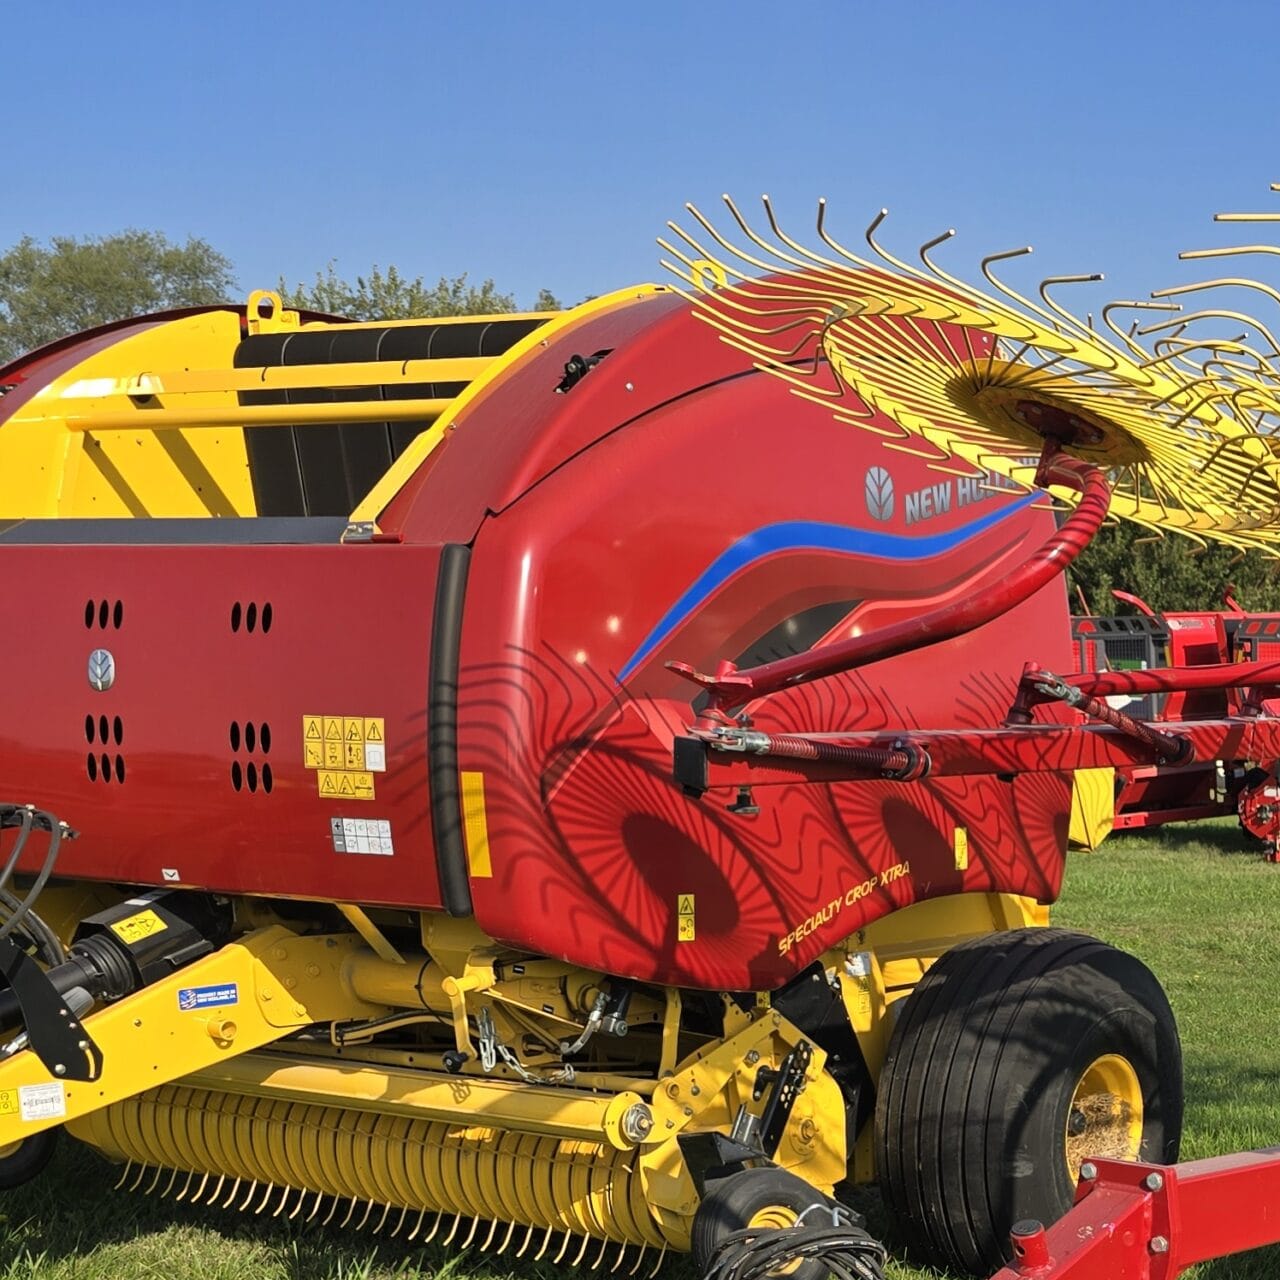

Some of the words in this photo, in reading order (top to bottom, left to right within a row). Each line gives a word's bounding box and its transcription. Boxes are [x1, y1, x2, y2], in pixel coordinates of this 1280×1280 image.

[904, 481, 951, 526] NEW
[778, 895, 843, 957] SPECIALTY
[845, 876, 878, 907] CROP
[880, 860, 911, 886] XTRA
